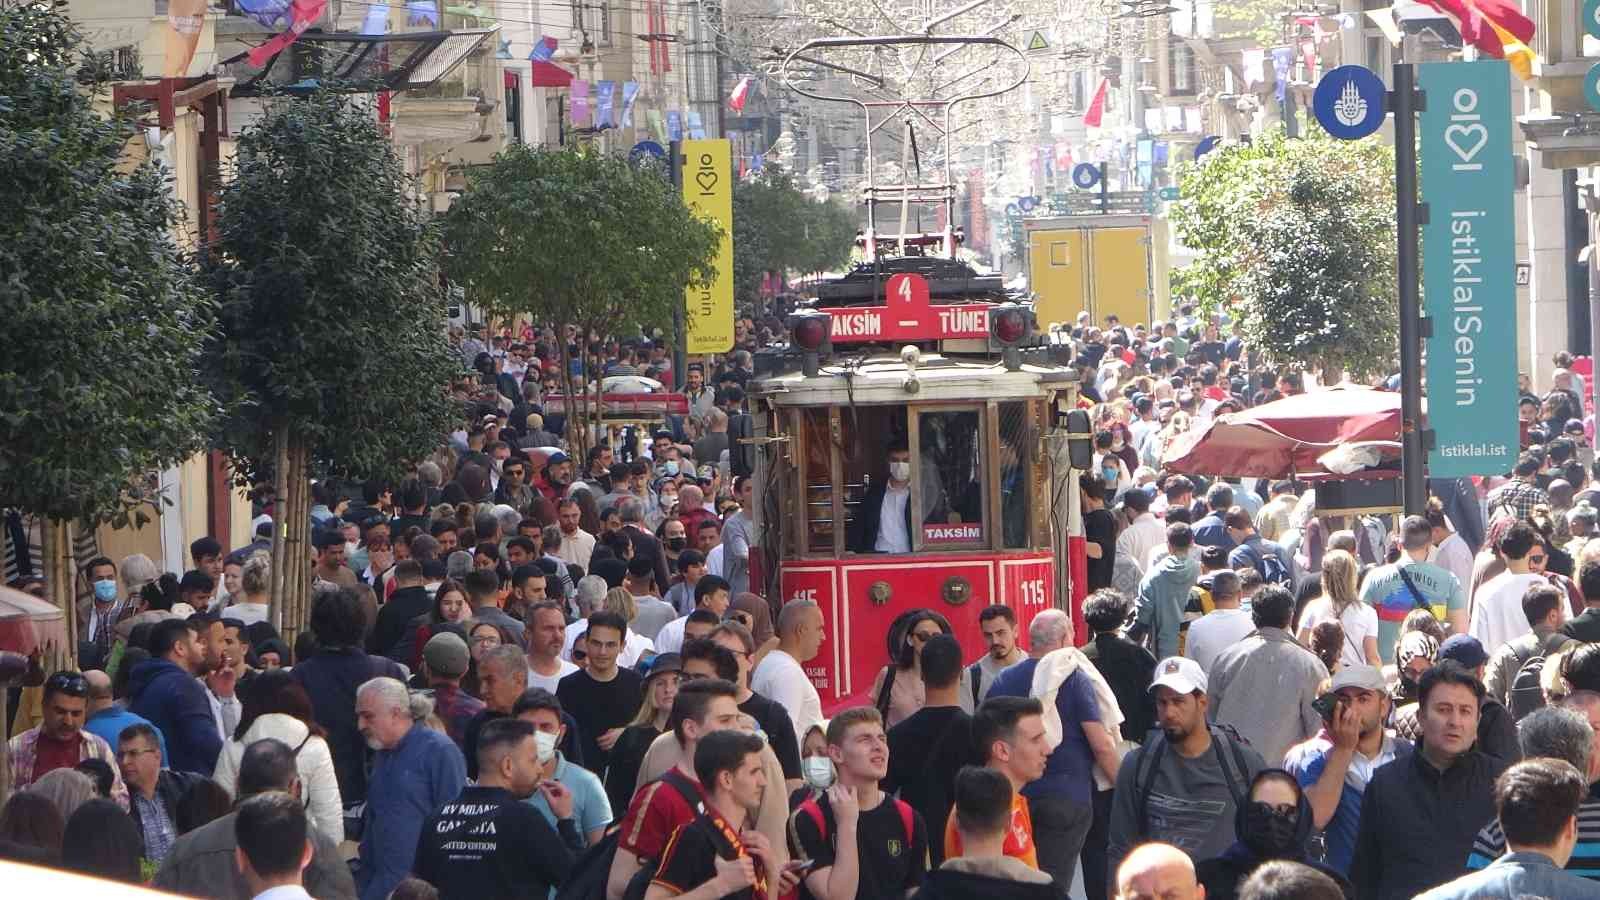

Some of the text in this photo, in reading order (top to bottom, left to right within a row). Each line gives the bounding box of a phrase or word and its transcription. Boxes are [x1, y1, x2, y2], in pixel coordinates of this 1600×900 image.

[898, 276, 912, 303] 4
[830, 310, 881, 337] AKSİM
[925, 526, 980, 539] TAKSİM
[1021, 580, 1045, 605] 115
